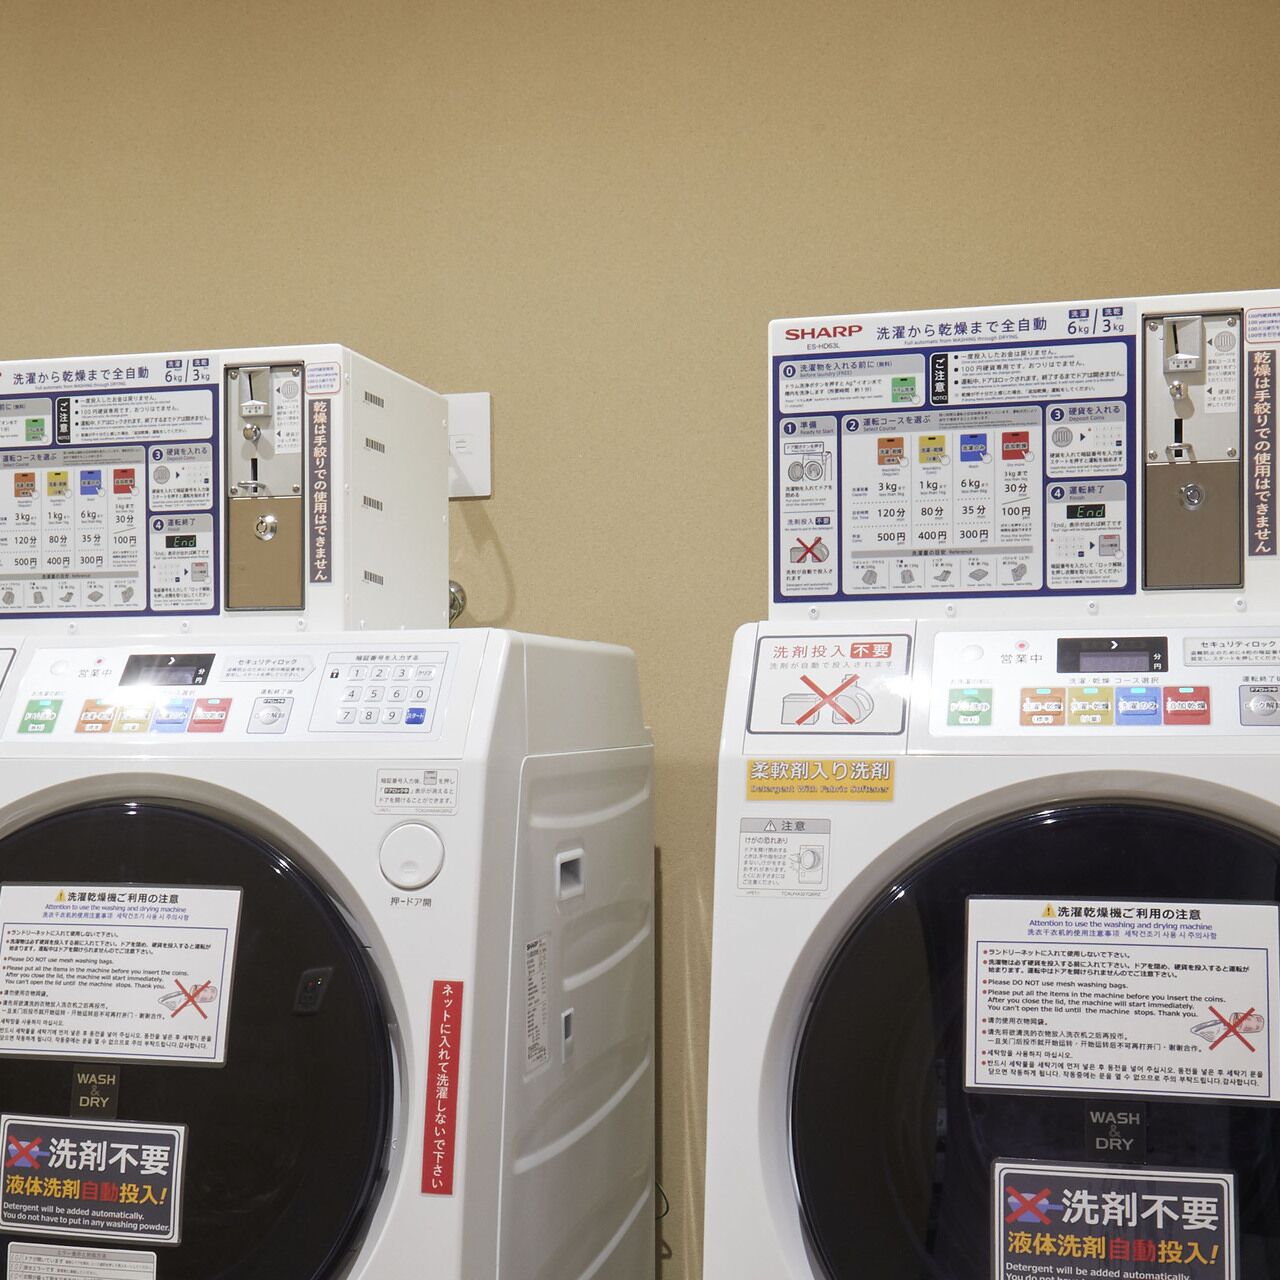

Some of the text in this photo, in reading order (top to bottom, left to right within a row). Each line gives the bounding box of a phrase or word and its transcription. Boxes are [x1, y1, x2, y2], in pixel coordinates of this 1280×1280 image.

[785, 325, 862, 340] SHARP
[876, 317, 1047, 341] 洗濯から乾燥まで全自動
[13, 366, 149, 385] 洗濯から乾燥まで全自動
[935, 359, 945, 392] ご注意
[1069, 406, 1120, 416] 硬貨を入れる
[863, 415, 930, 426] 運転コースを選ぶ
[3, 453, 56, 462] 運転コースを選ぶ
[1254, 351, 1271, 552] 乾燥は手絞りでの使用はできません
[313, 401, 327, 580] 乾燥は手絞りでの使用はできません
[1070, 485, 1105, 495] 運転終了
[1076, 506, 1104, 517] End
[1200, 640, 1277, 648] セキュリティロック
[773, 643, 890, 658] 洗剤投入 不要
[1153, 652, 1161, 661] 分
[1000, 653, 1043, 664] 営業中
[769, 661, 893, 670] 洗剤が自動で投入されます
[1153, 662, 1161, 670] 円
[78, 669, 112, 678] 営業中
[751, 761, 890, 779] 柔軟剤入り洗剤
[782, 821, 806, 831] 注意
[68, 892, 179, 904] 洗濯乾燥機ご利用の注意
[1058, 906, 1201, 920] 洗濯乾燥機ご利用の注意
[1104, 921, 1135, 929] washing
[1153, 922, 1177, 930] drying
[1109, 982, 1128, 990] bags.
[78, 1073, 115, 1085] WASH
[431, 984, 453, 1189] ネットに入れて洗濯しないで下さい
[80, 1097, 109, 1107] DRY
[1090, 1112, 1140, 1124] WASH
[1095, 1138, 1134, 1150] DRY
[48, 1138, 170, 1175] 洗剤不要
[1062, 1189, 1219, 1231] 洗剤不要
[1006, 1263, 1053, 1273] Detergent
[1056, 1266, 1072, 1274] will
[1090, 1269, 1119, 1277] added
